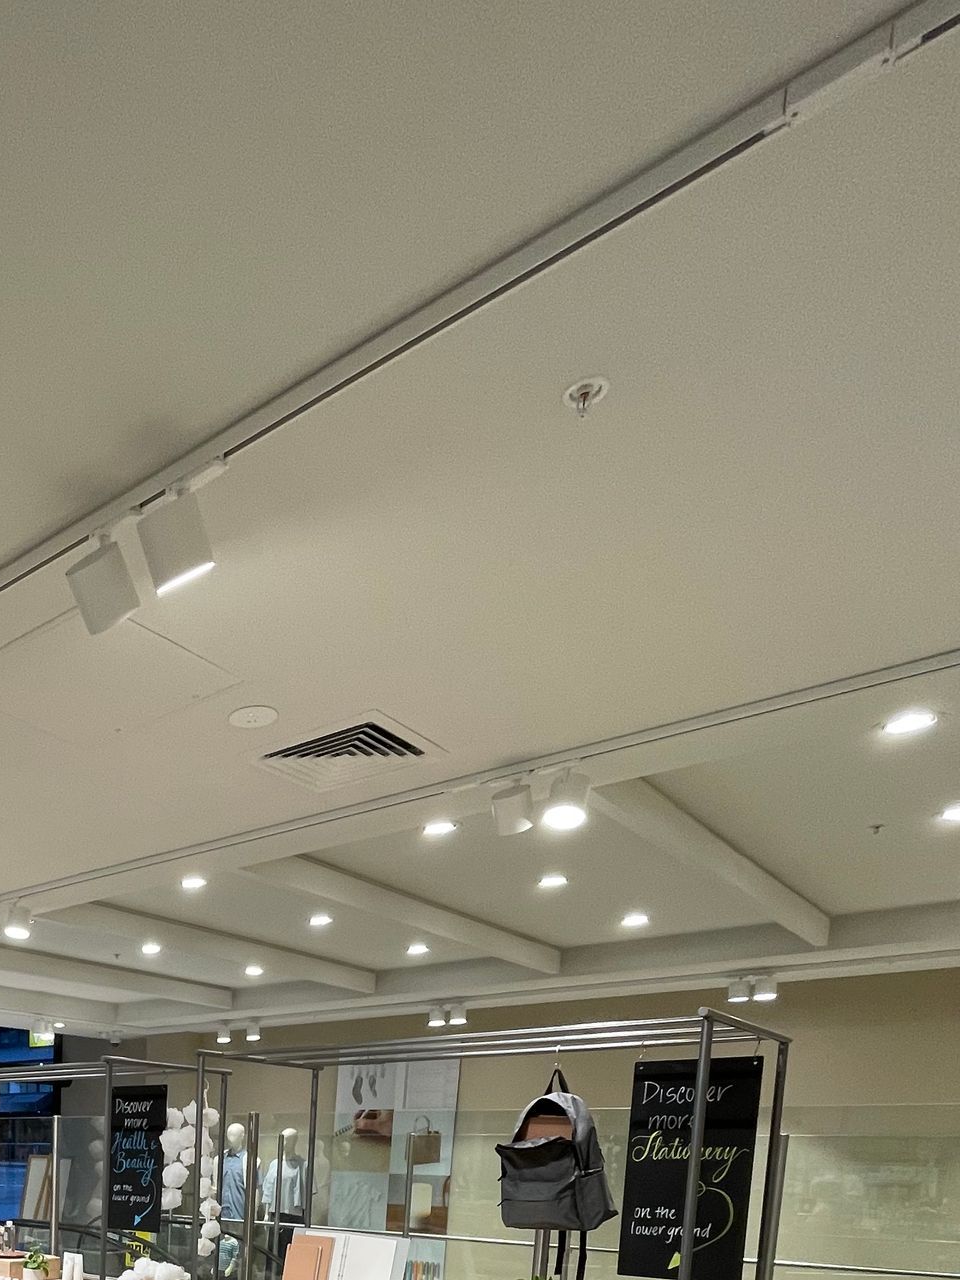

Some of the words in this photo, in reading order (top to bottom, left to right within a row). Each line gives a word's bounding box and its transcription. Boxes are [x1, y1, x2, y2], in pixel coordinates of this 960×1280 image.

[642, 1081, 734, 1105] Discoer
[115, 1098, 153, 1114] Discover
[124, 1117, 149, 1130] more
[111, 1129, 149, 1154] Health
[631, 1130, 750, 1183] Statioery
[113, 1151, 158, 1187] Beauty
[113, 1184, 121, 1192] on
[122, 1184, 133, 1192] the
[129, 1194, 151, 1206] ground
[634, 1207, 652, 1219] on
[655, 1206, 677, 1220] the
[630, 1221, 666, 1235] lower
[665, 1223, 712, 1244] grnd
